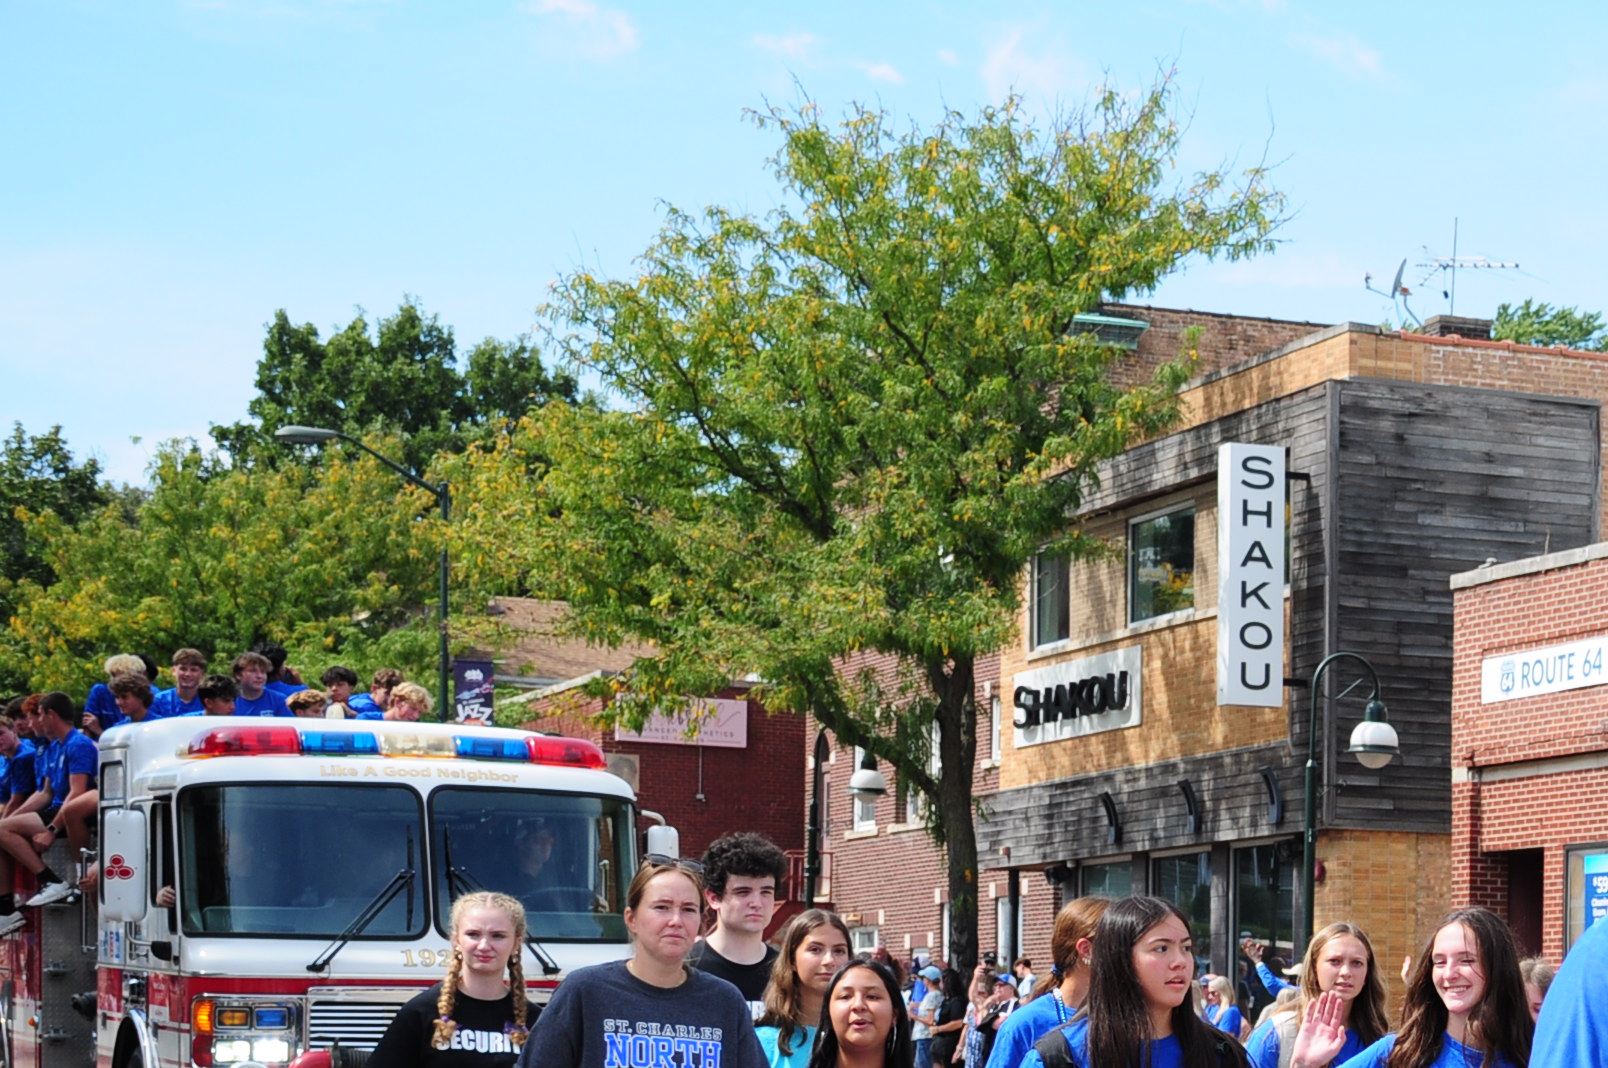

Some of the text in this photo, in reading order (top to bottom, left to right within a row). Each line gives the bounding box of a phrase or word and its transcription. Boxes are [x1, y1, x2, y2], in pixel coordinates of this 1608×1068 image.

[1239, 455, 1275, 691] SHAKOU
[1521, 652, 1576, 689] ROUTE
[1582, 647, 1603, 678] 64
[1013, 669, 1129, 729] SHAKOU
[455, 703, 493, 726] JAZZ
[320, 765, 519, 783] Like A Good Neighbor
[400, 948, 457, 968] 192
[436, 1028, 522, 1055] ECURI
[603, 1018, 723, 1041] ST. CHARLES
